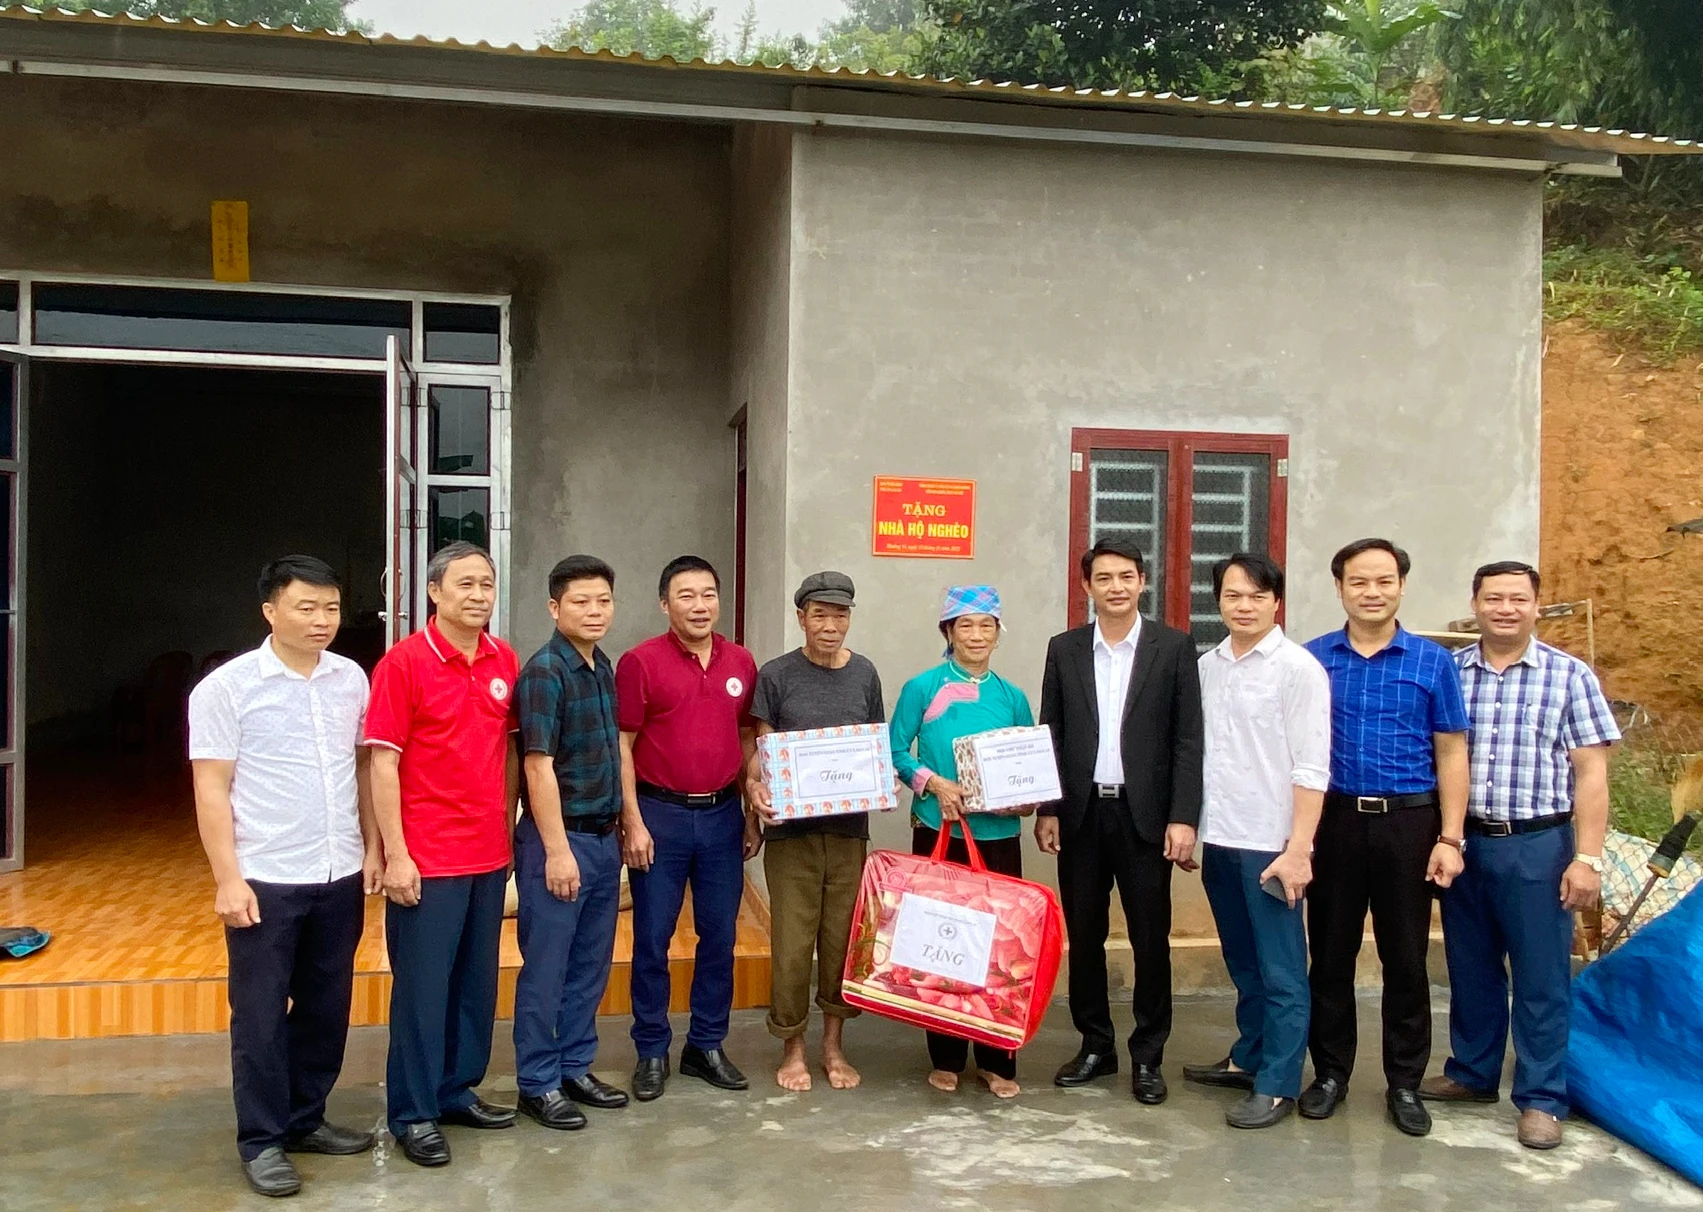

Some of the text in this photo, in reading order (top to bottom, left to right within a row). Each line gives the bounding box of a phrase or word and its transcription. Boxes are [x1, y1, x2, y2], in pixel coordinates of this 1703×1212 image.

[902, 501, 947, 518] TẶNG
[878, 519, 905, 536] NHÀ
[907, 520, 925, 539] HỘ
[819, 769, 853, 783] Tặng
[1007, 774, 1035, 787] Tặng
[921, 943, 965, 966] TẶNG
